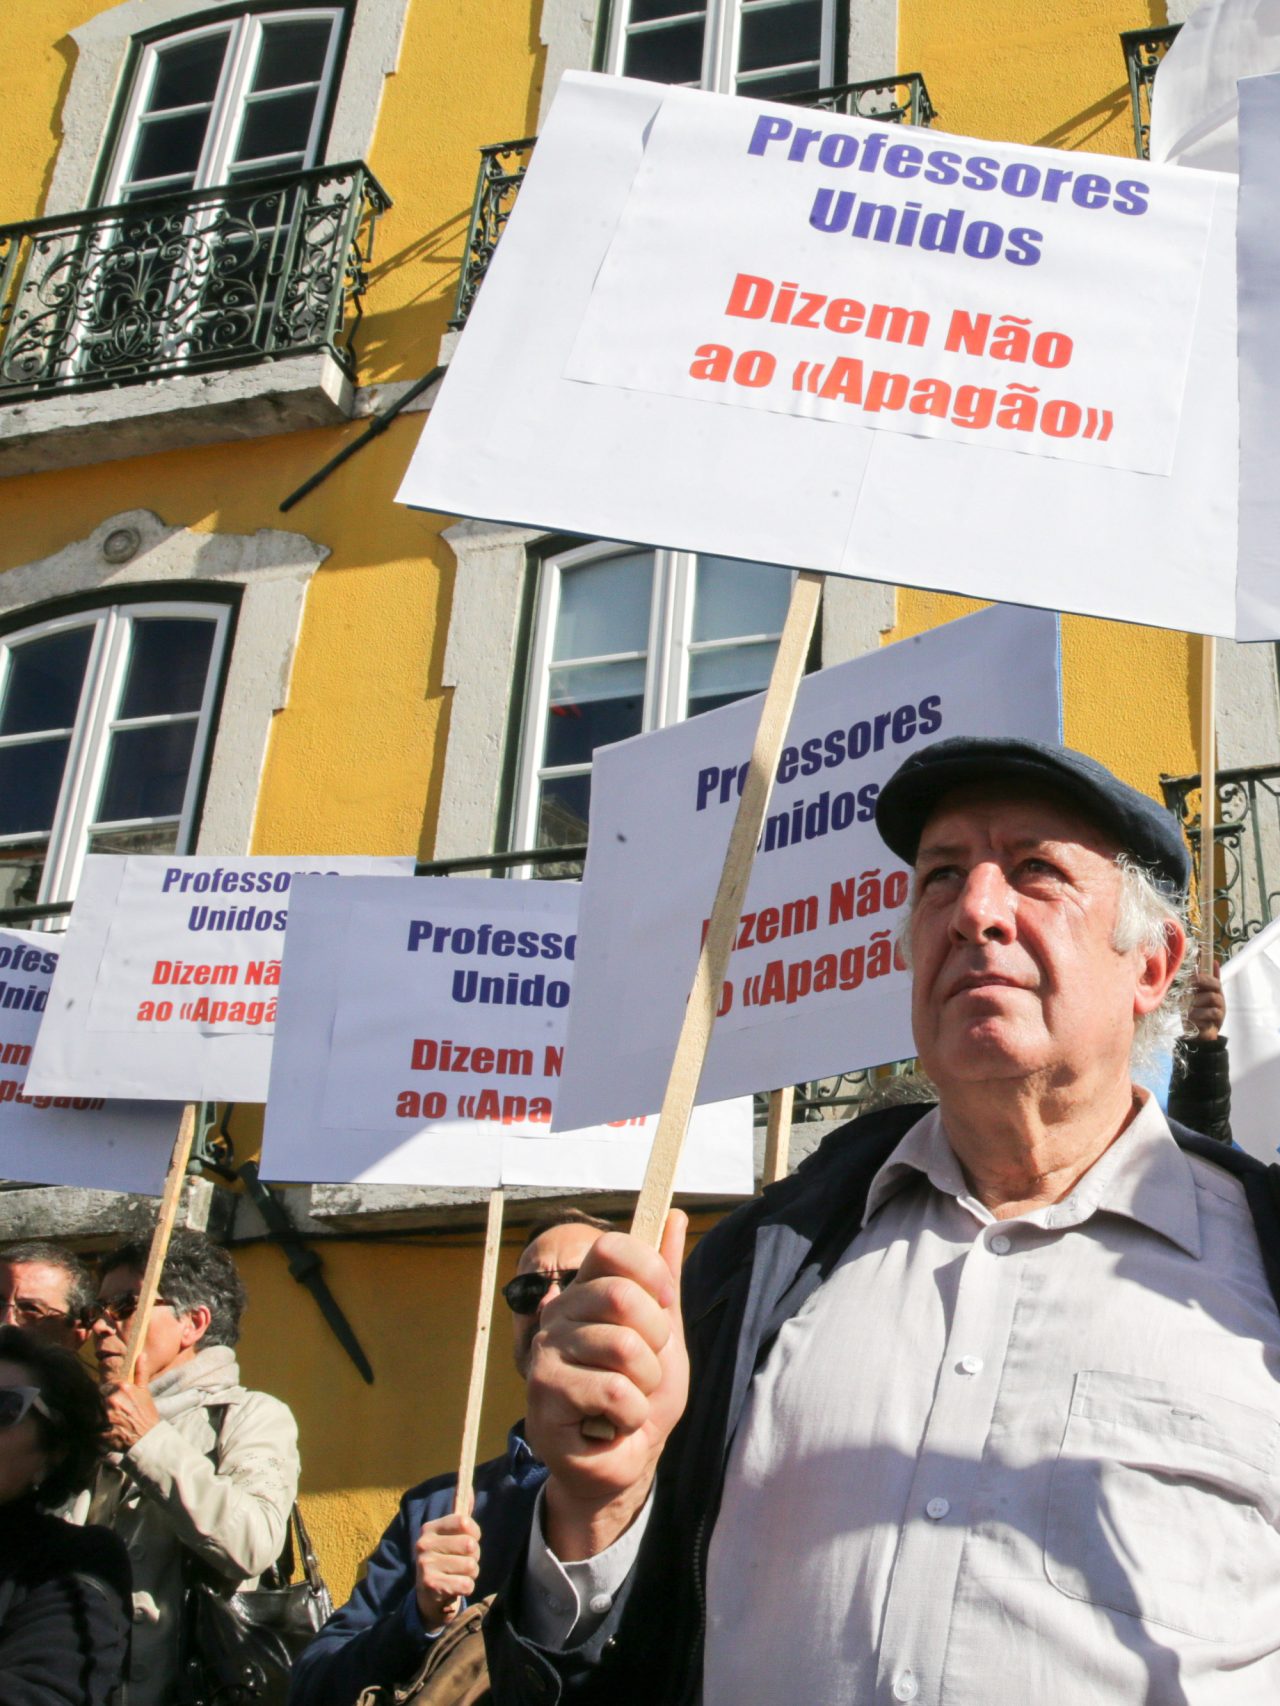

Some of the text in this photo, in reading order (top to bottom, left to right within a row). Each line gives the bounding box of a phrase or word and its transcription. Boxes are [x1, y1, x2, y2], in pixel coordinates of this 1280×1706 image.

[747, 114, 1150, 216] Professores
[808, 187, 1044, 266] Unidos
[724, 273, 1074, 369] Dizem Não
[688, 343, 1114, 442] ao «Apagão»
[756, 783, 880, 853] nidos
[162, 868, 340, 893] Professo
[188, 906, 288, 931] Unidos
[701, 868, 909, 954] zem Não
[152, 959, 282, 986] Dizem Nã
[451, 970, 571, 1008] Unido
[137, 997, 278, 1026] ao «Apagã
[411, 1039, 534, 1076] Dizem
[395, 1090, 448, 1119] ao
